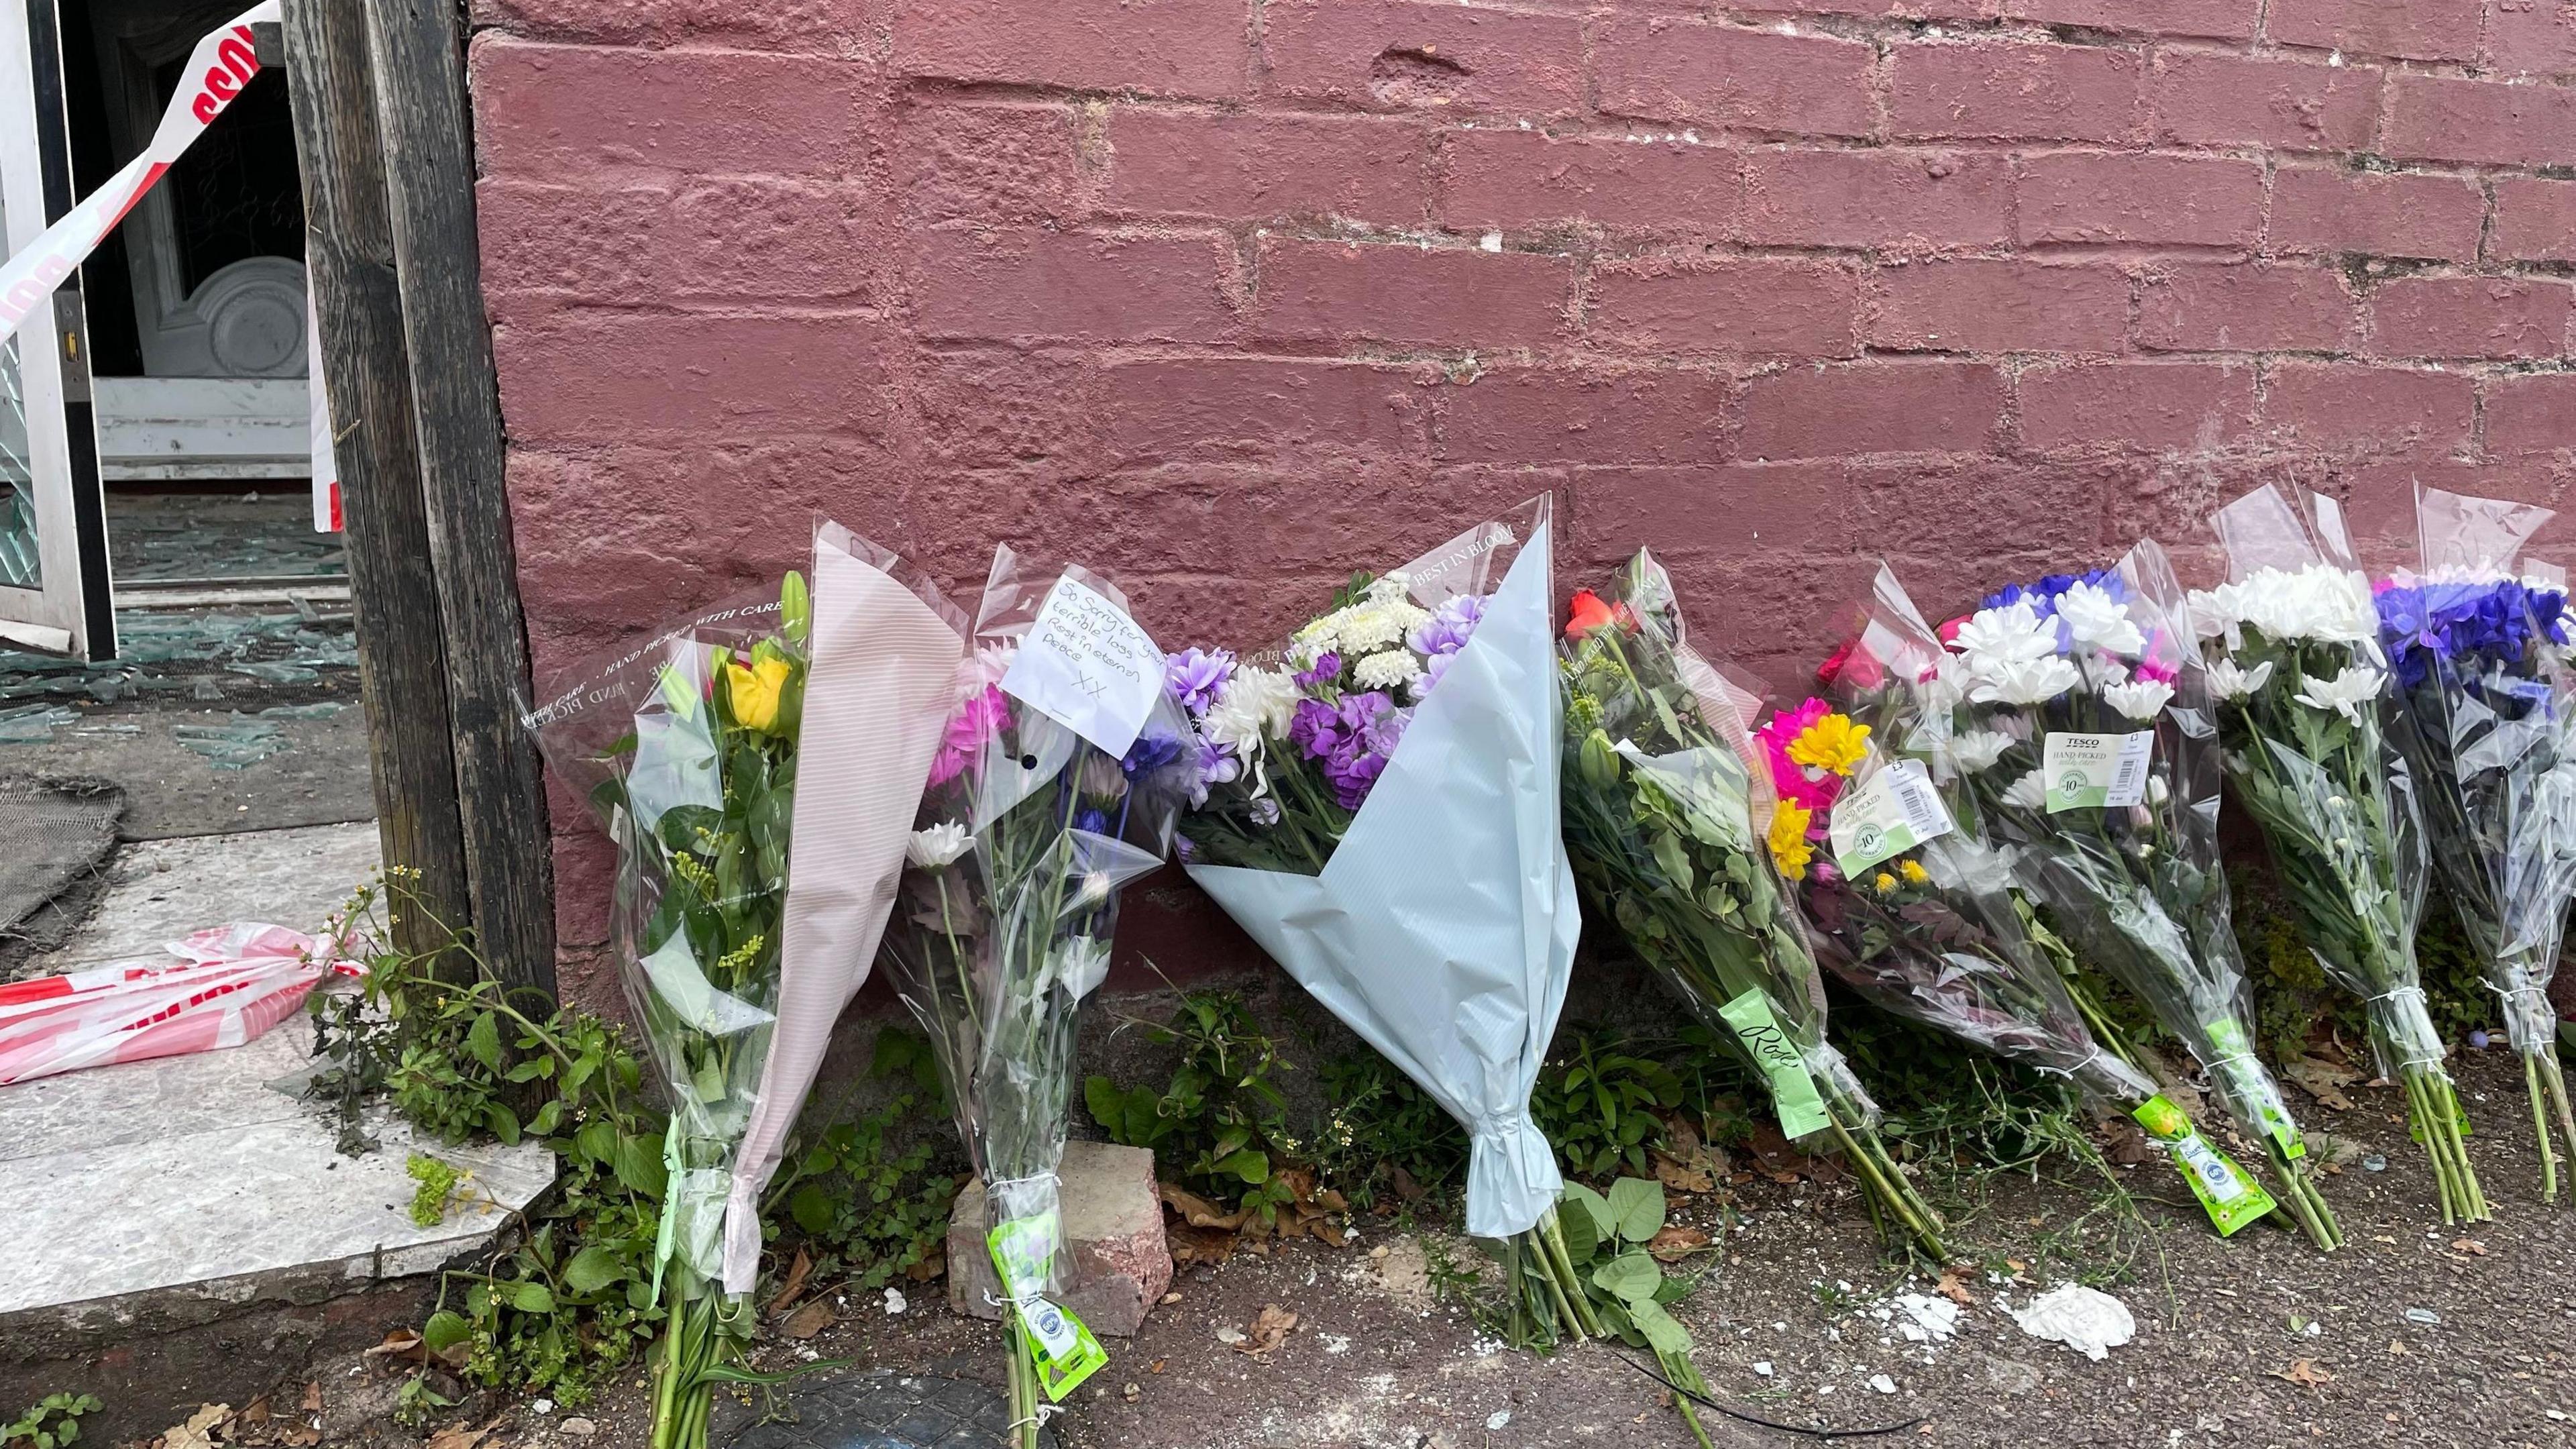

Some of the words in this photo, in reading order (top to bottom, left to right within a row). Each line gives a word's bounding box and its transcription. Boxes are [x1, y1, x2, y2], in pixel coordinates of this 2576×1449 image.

[1413, 559, 1450, 586] BEST
[1449, 549, 1468, 567] IN
[1467, 524, 1515, 557] BLOOM
[1053, 602, 1101, 637] terrible
[1059, 583, 1077, 601] So
[1079, 597, 1118, 632] Sorry
[1120, 627, 1143, 641] for
[1138, 645, 1165, 666] your
[1613, 602, 1630, 625] CARE
[604, 650, 641, 677] HAND
[643, 624, 691, 654] PICKED
[696, 609, 737, 625] WITH
[740, 600, 785, 616] CARE
[1047, 618, 1077, 639] Rest
[1079, 636, 1091, 651] in
[556, 682, 587, 707] CARE
[2068, 738, 2099, 746] TESCO
[1892, 761, 1903, 772] £3
[2053, 751, 2076, 759] HAND
[2065, 780, 2077, 792] 10
[1837, 810, 1856, 826] HAND
[1856, 794, 1881, 813] PICKED
[1861, 834, 1874, 849] 10
[1739, 1022, 1799, 1068] Rose
[1042, 1315, 1061, 1331] 60%
